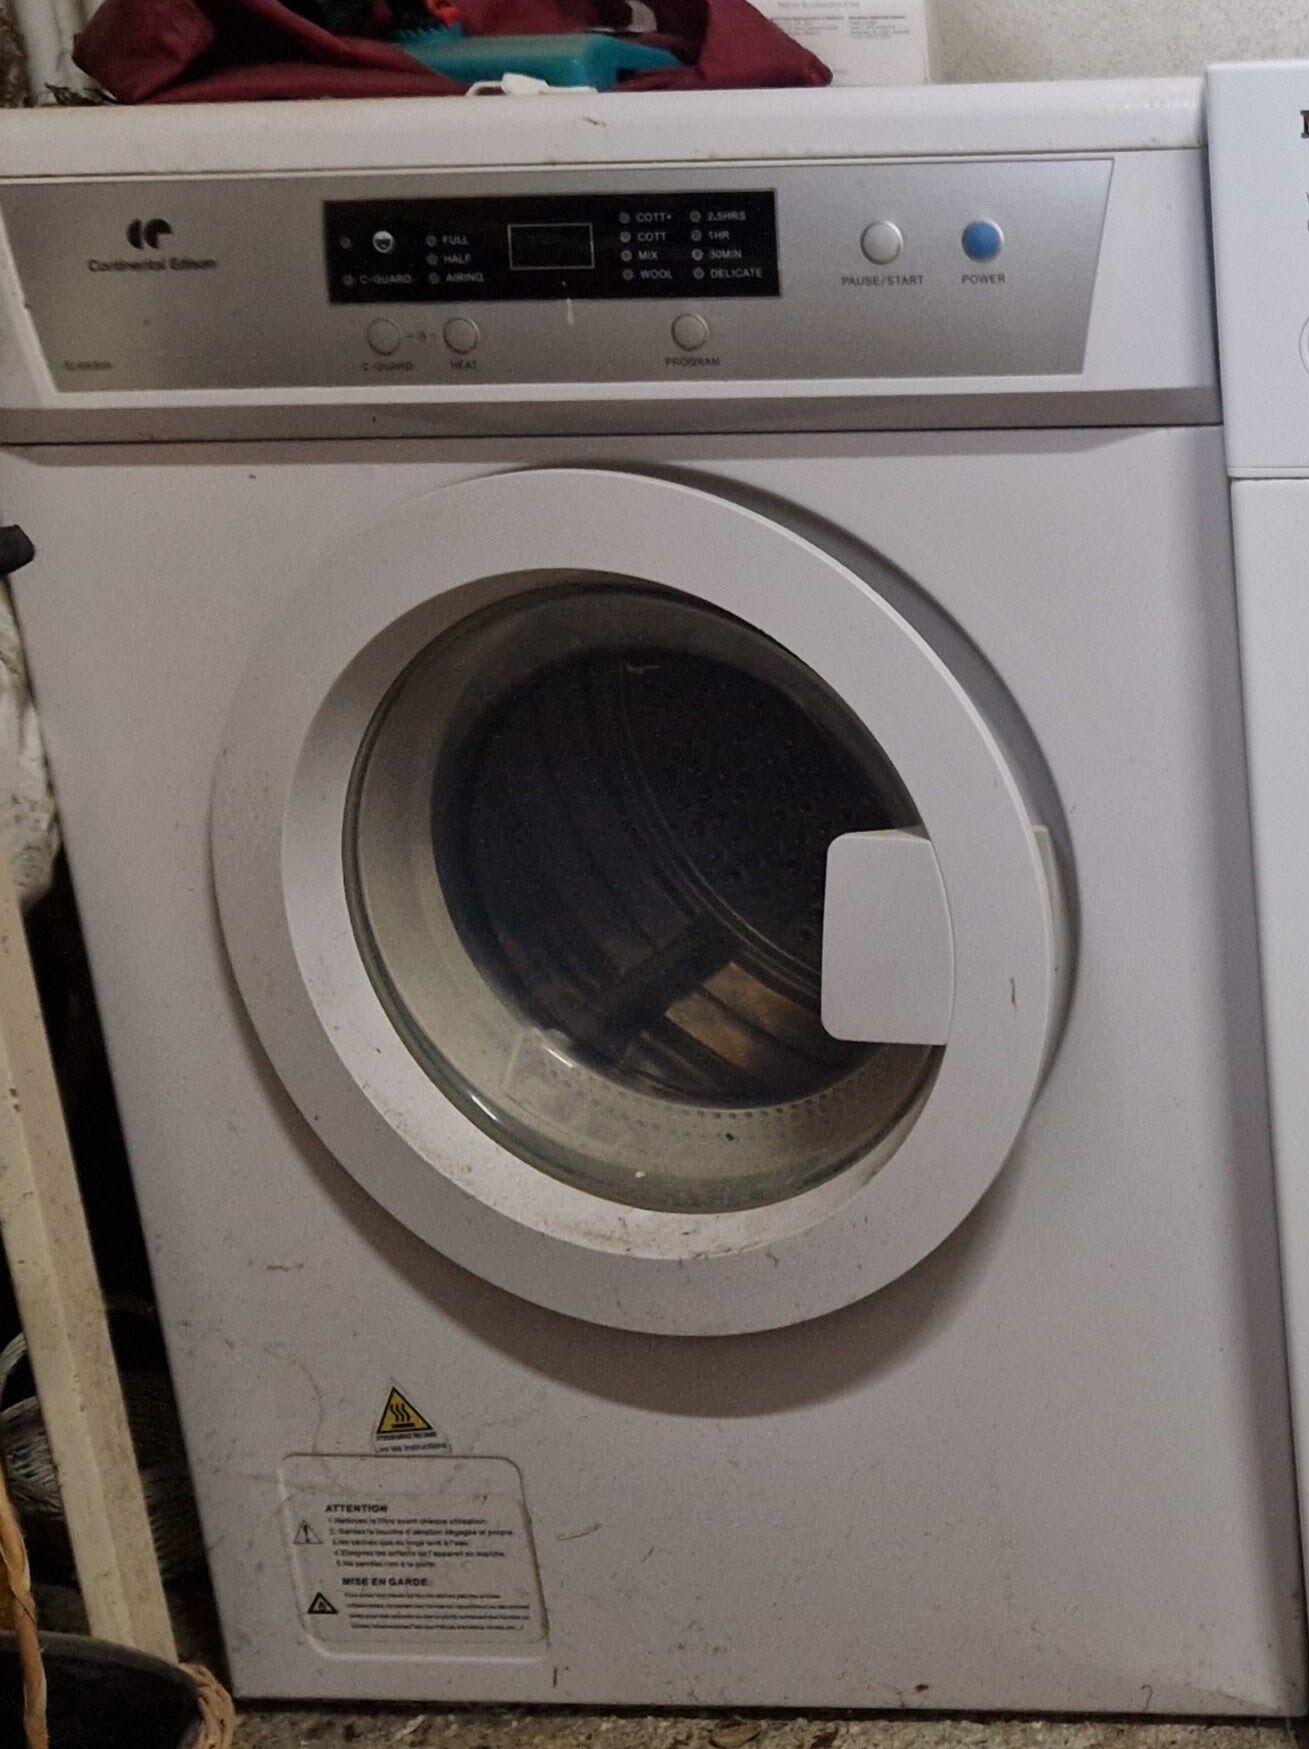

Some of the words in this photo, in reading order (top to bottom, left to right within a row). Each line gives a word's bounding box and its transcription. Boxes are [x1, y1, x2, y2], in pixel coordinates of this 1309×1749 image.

[442, 235, 470, 246] FULL
[637, 231, 667, 242] COTT
[443, 254, 472, 265] HALF
[638, 250, 660, 261] MIX
[445, 272, 484, 283] AIRING
[640, 268, 673, 280] WOOL
[710, 267, 764, 279] DELICATE
[841, 274, 925, 287] PAUSE/START
[961, 273, 1006, 285] POWER
[449, 360, 477, 371] HEAT
[665, 357, 721, 368] PROGRAM
[325, 1504, 388, 1513] ATTENTION
[342, 1577, 369, 1587] MISE
[371, 1577, 387, 1587] EN
